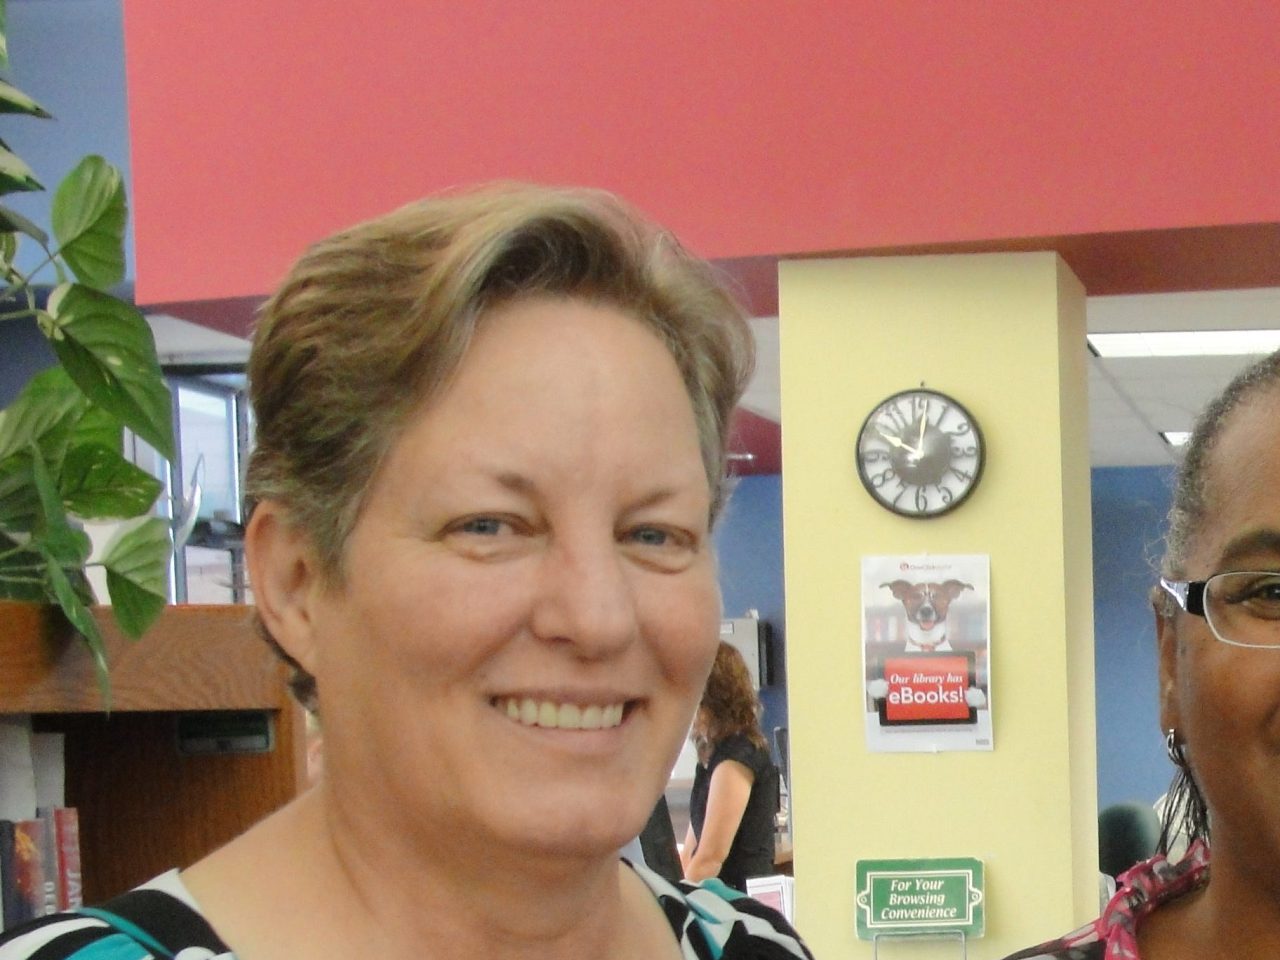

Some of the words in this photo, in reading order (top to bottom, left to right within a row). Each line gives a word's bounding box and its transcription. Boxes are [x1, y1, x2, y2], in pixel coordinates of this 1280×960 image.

[871, 468, 896, 488] 8
[915, 484, 928, 512] 6
[890, 673, 909, 684] Our
[912, 672, 944, 685] library
[946, 672, 963, 683] has
[889, 685, 963, 704] eBooks!
[891, 879, 912, 891] For
[915, 878, 944, 891] Your
[889, 892, 945, 906] Browsing
[881, 906, 957, 920] Convenience
